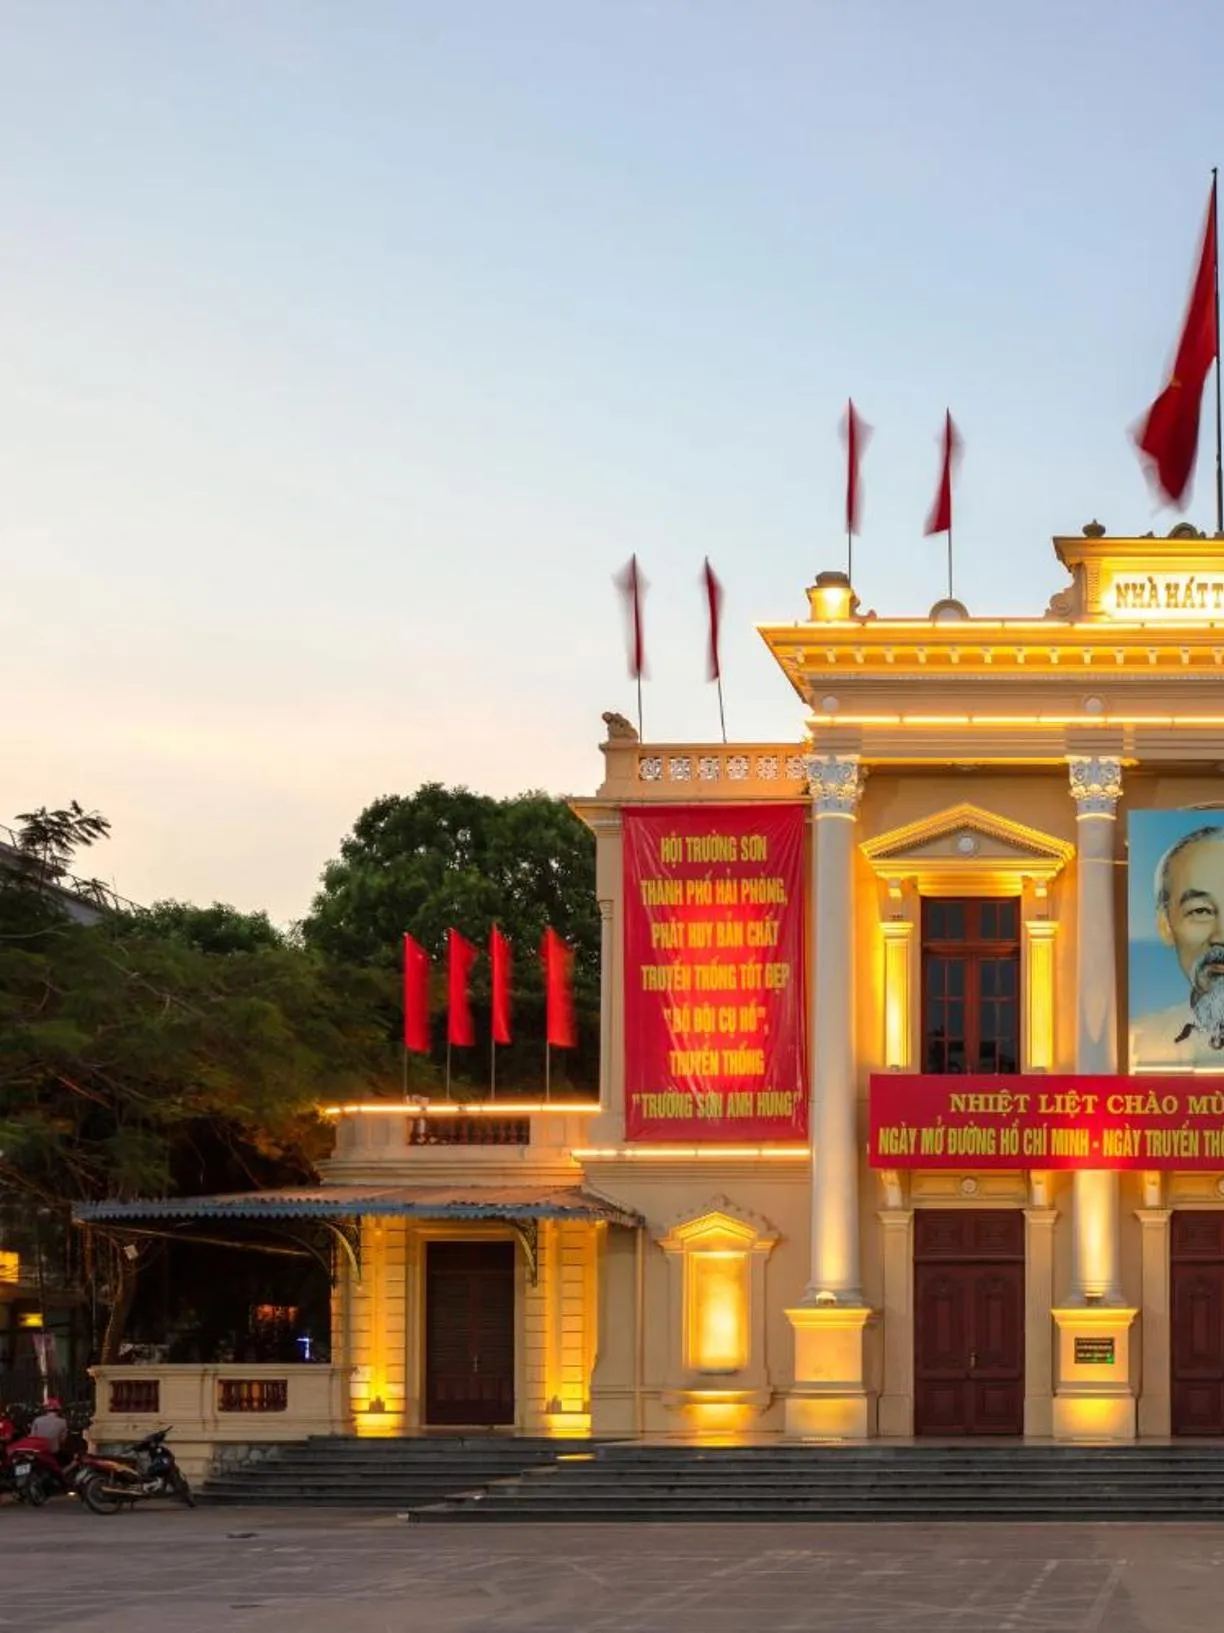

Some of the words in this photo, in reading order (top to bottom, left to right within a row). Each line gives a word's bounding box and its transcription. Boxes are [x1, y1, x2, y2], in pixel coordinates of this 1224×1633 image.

[1115, 576, 1160, 609] NHÀ
[1165, 576, 1208, 609] HÁT
[661, 832, 682, 868] HỘI
[686, 830, 737, 862] TRƯỜNG
[741, 835, 767, 861] SƠN
[641, 874, 683, 906] THÀNH
[686, 870, 712, 906] PHỐ
[716, 868, 737, 905] HẢI
[950, 1089, 1031, 1116] NHIỆT
[1038, 1089, 1098, 1118] LIỆT
[1106, 1090, 1178, 1115] CHÀO
[879, 1122, 916, 1155] NGÀY
[921, 1116, 945, 1155] MỞ
[948, 1121, 996, 1155] ĐƯỜNG
[1000, 1119, 1019, 1155] HỒ
[1023, 1123, 1048, 1156] CHÍ
[1051, 1129, 1089, 1156] MINH
[1103, 1123, 1141, 1157] NGÀY
